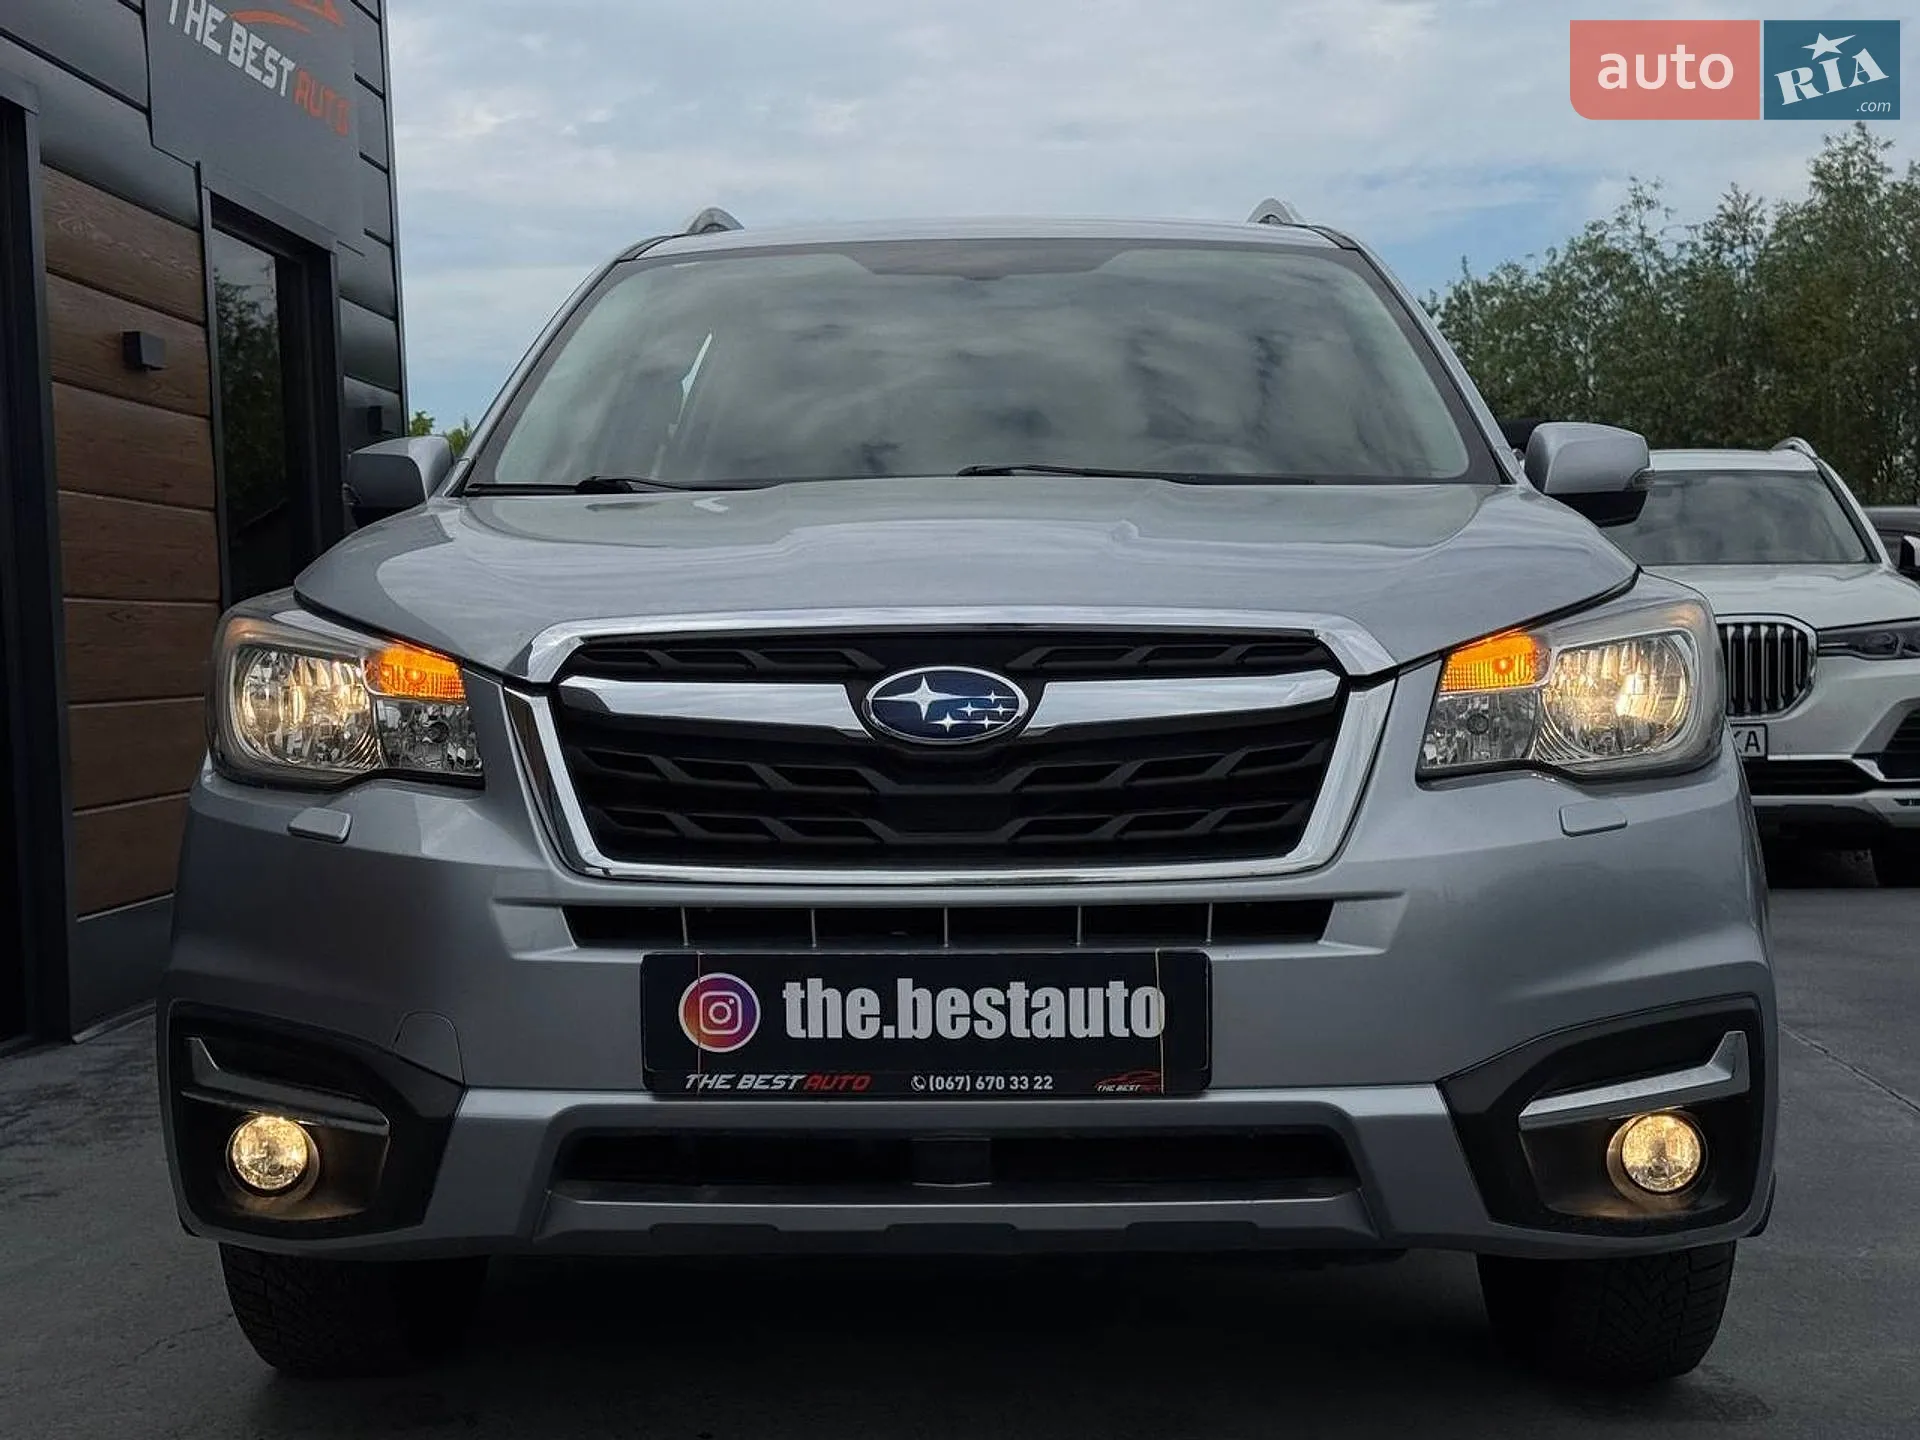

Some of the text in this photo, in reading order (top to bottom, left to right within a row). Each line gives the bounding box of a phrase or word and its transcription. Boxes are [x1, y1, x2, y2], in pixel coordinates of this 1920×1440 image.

[228, 22, 296, 97] BEST
[294, 67, 350, 136] AUTO
[783, 978, 1165, 1039] the.bestauto
[686, 1073, 872, 1091] THE BEST AUTO
[929, 1075, 1054, 1092] (067) 670 33 22
